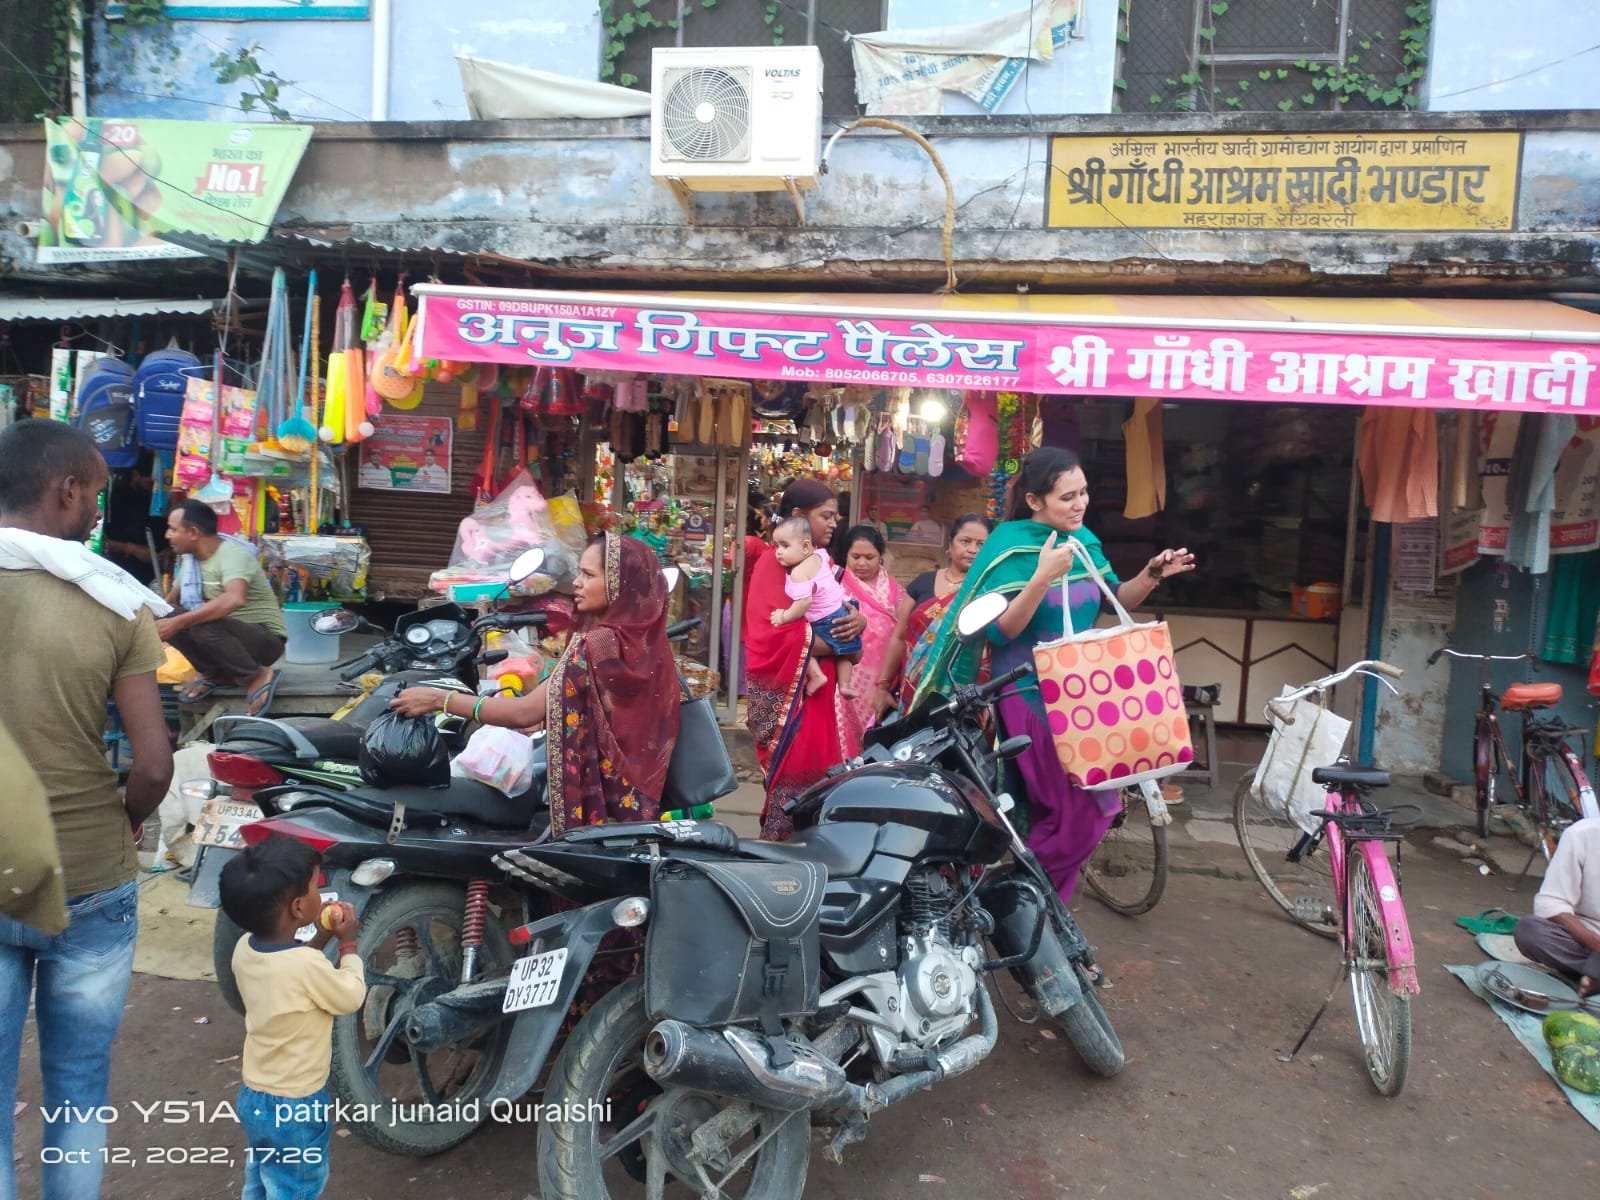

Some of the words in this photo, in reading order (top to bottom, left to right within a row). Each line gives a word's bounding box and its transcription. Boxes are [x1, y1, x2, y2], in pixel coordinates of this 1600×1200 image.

[764, 68, 801, 78] VOLTAS
[1109, 138, 1159, 157] अखिल
[1163, 138, 1218, 157] भारतीय
[1222, 138, 1259, 156] खादी
[1261, 136, 1330, 157] ग्रामोद्योग
[1333, 136, 1378, 155] आयोग
[1409, 135, 1468, 155] प्रमाणित
[206, 163, 260, 192] No.1
[1067, 157, 1106, 205] श्री
[1107, 158, 1185, 205] गाँधी
[1186, 165, 1282, 205] आश्रम
[1285, 156, 1361, 205] खादी
[1366, 165, 1490, 204] भण्डार
[456, 298, 497, 313] GSTIN:
[456, 312, 624, 362] अनुज
[634, 309, 830, 362] गिफ्ट
[836, 319, 1027, 373] पैलेस
[781, 365, 821, 379] Mob:
[825, 368, 922, 384] 8052066705,
[926, 372, 1020, 387] 6307626177
[1046, 334, 1115, 389] श्री
[1126, 335, 1253, 392] गाँधी
[1266, 351, 1436, 399] आश्रम
[1448, 350, 1597, 407] खादी
[201, 822, 241, 846] 754
[521, 959, 538, 981] UP
[537, 955, 554, 978] 32
[504, 979, 558, 1010] DY3777
